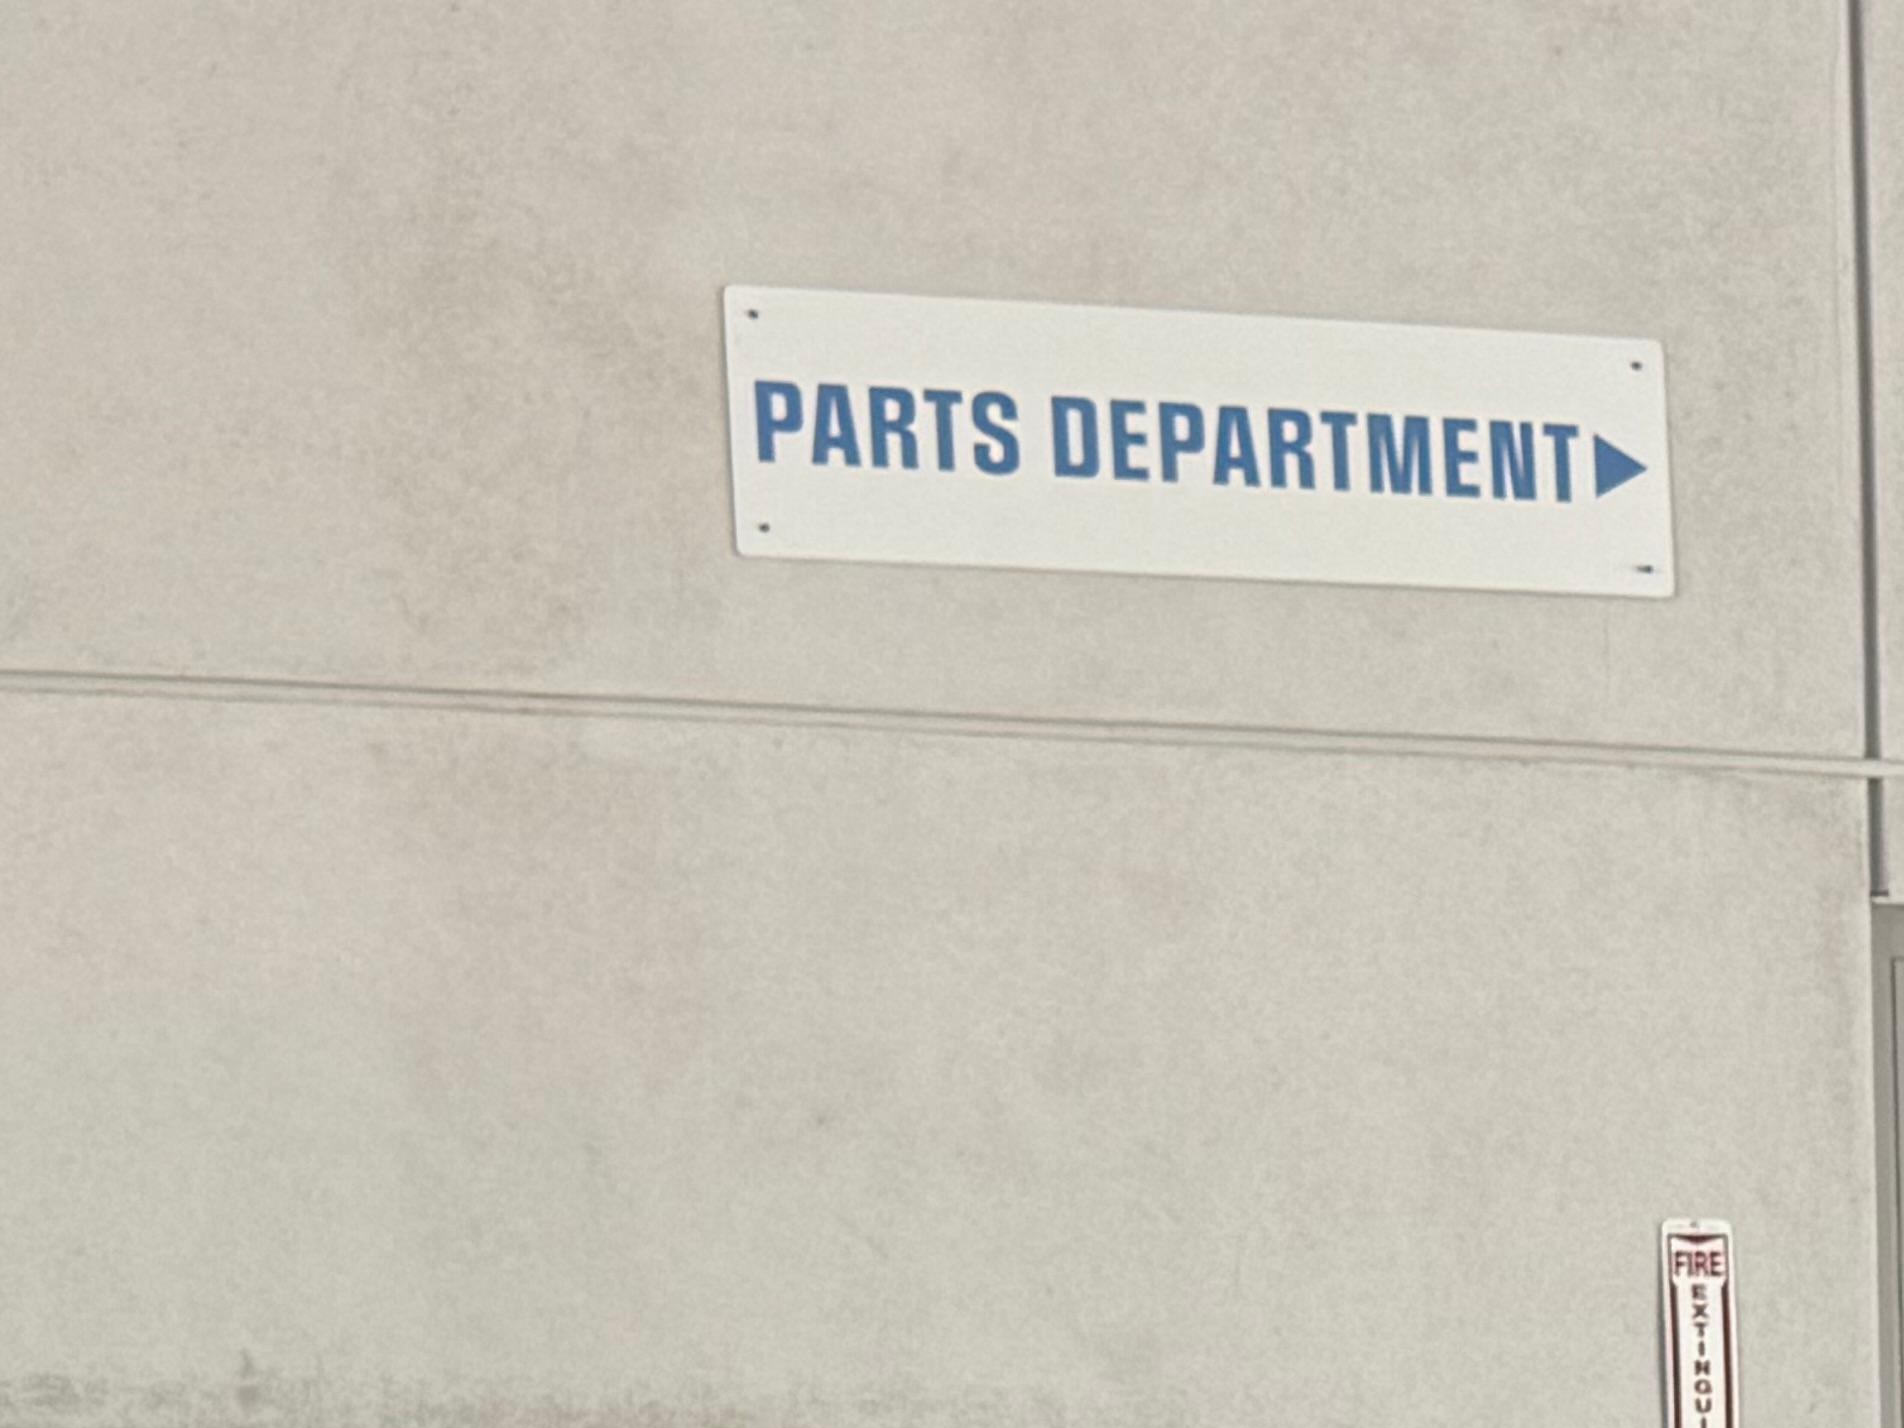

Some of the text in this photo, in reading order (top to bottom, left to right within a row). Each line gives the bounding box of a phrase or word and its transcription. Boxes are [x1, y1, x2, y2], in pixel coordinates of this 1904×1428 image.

[754, 380, 1579, 503] PARTS DEPARTMENT
[1674, 1250, 1723, 1277] FIRE
